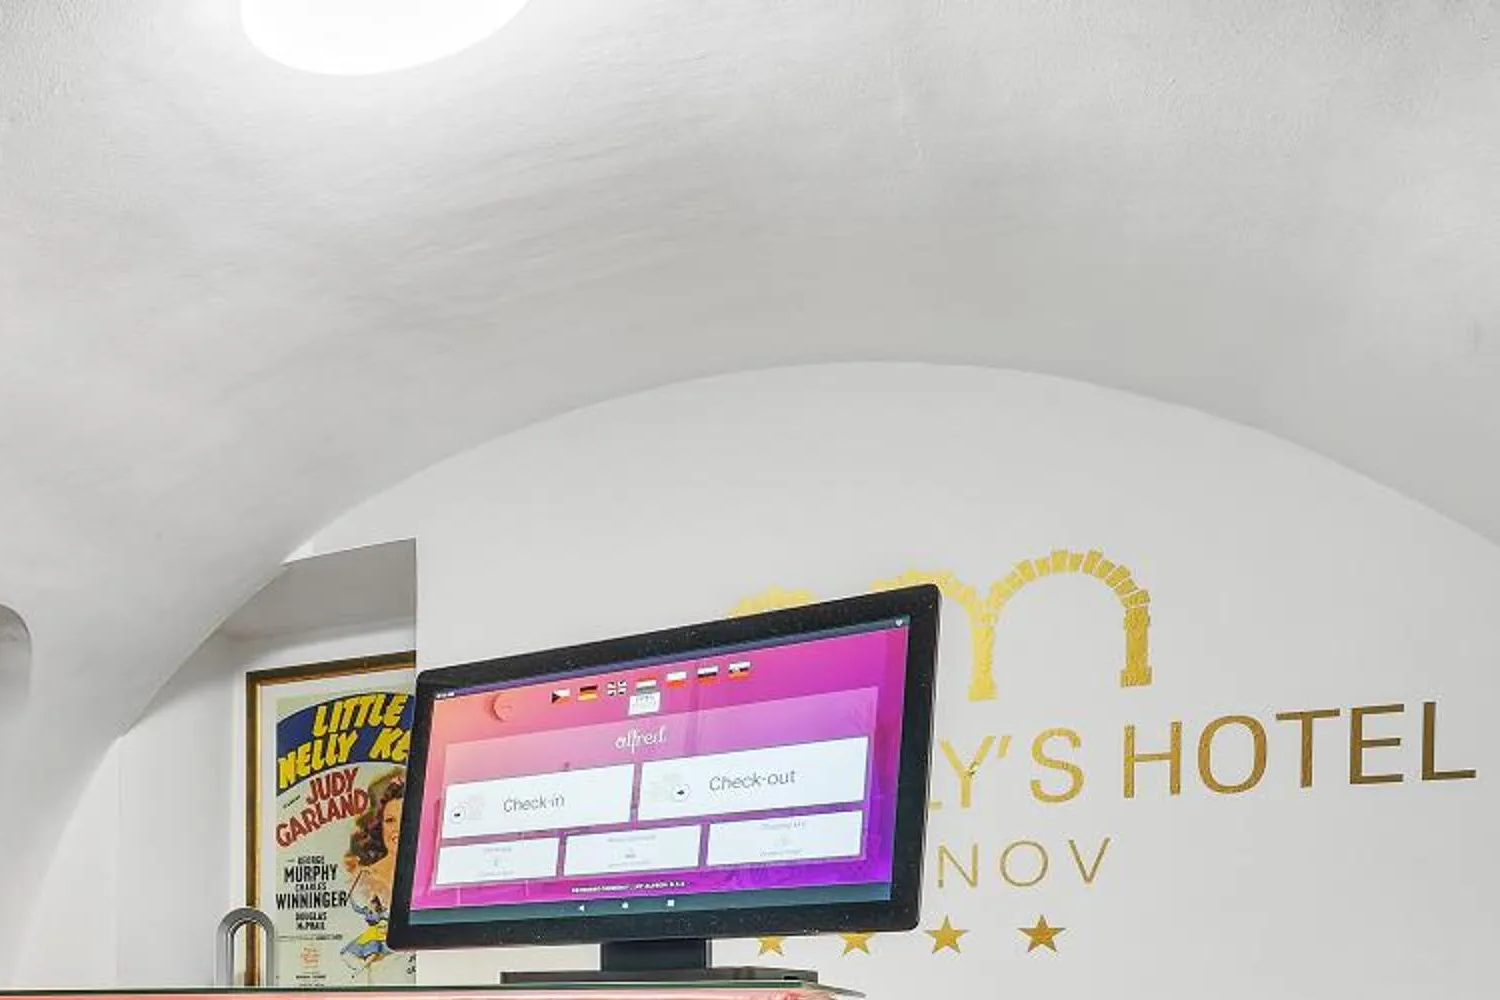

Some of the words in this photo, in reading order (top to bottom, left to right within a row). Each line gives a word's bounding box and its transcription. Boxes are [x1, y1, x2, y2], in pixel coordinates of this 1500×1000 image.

[313, 693, 408, 737] LITTLE
[278, 730, 358, 789] NELLY
[929, 727, 1085, 809] Y'S
[1121, 701, 1477, 799] HOTEL
[306, 767, 359, 804] JUDY
[709, 770, 796, 791] Check-out
[276, 789, 369, 847] GARLAND
[503, 793, 565, 813] Check-in
[284, 864, 338, 883] MURPHY
[937, 838, 1111, 888] NOV
[276, 890, 349, 910] WINNINGER
